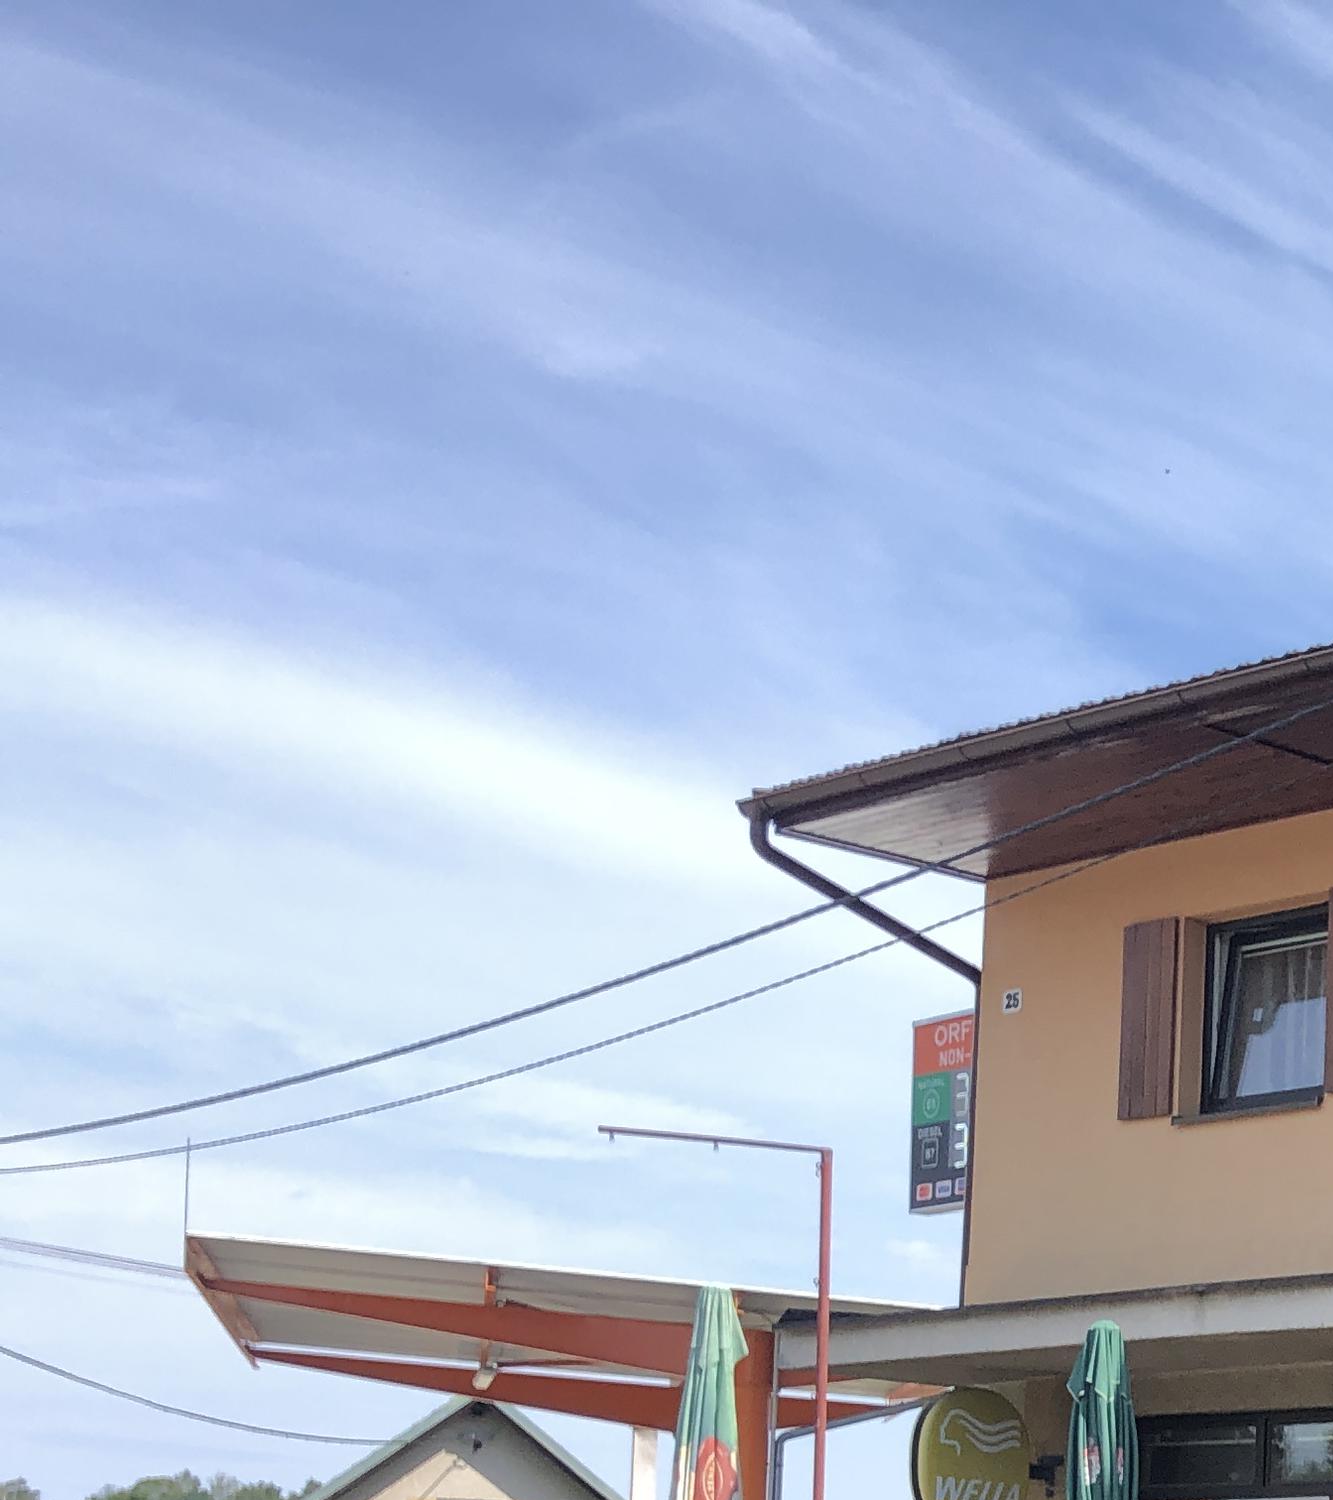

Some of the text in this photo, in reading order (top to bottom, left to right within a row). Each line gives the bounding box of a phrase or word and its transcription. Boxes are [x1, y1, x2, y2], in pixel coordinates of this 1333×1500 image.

[1004, 991, 1020, 1010] 25
[934, 1019, 973, 1047] ORF
[939, 1047, 974, 1067] NON-
